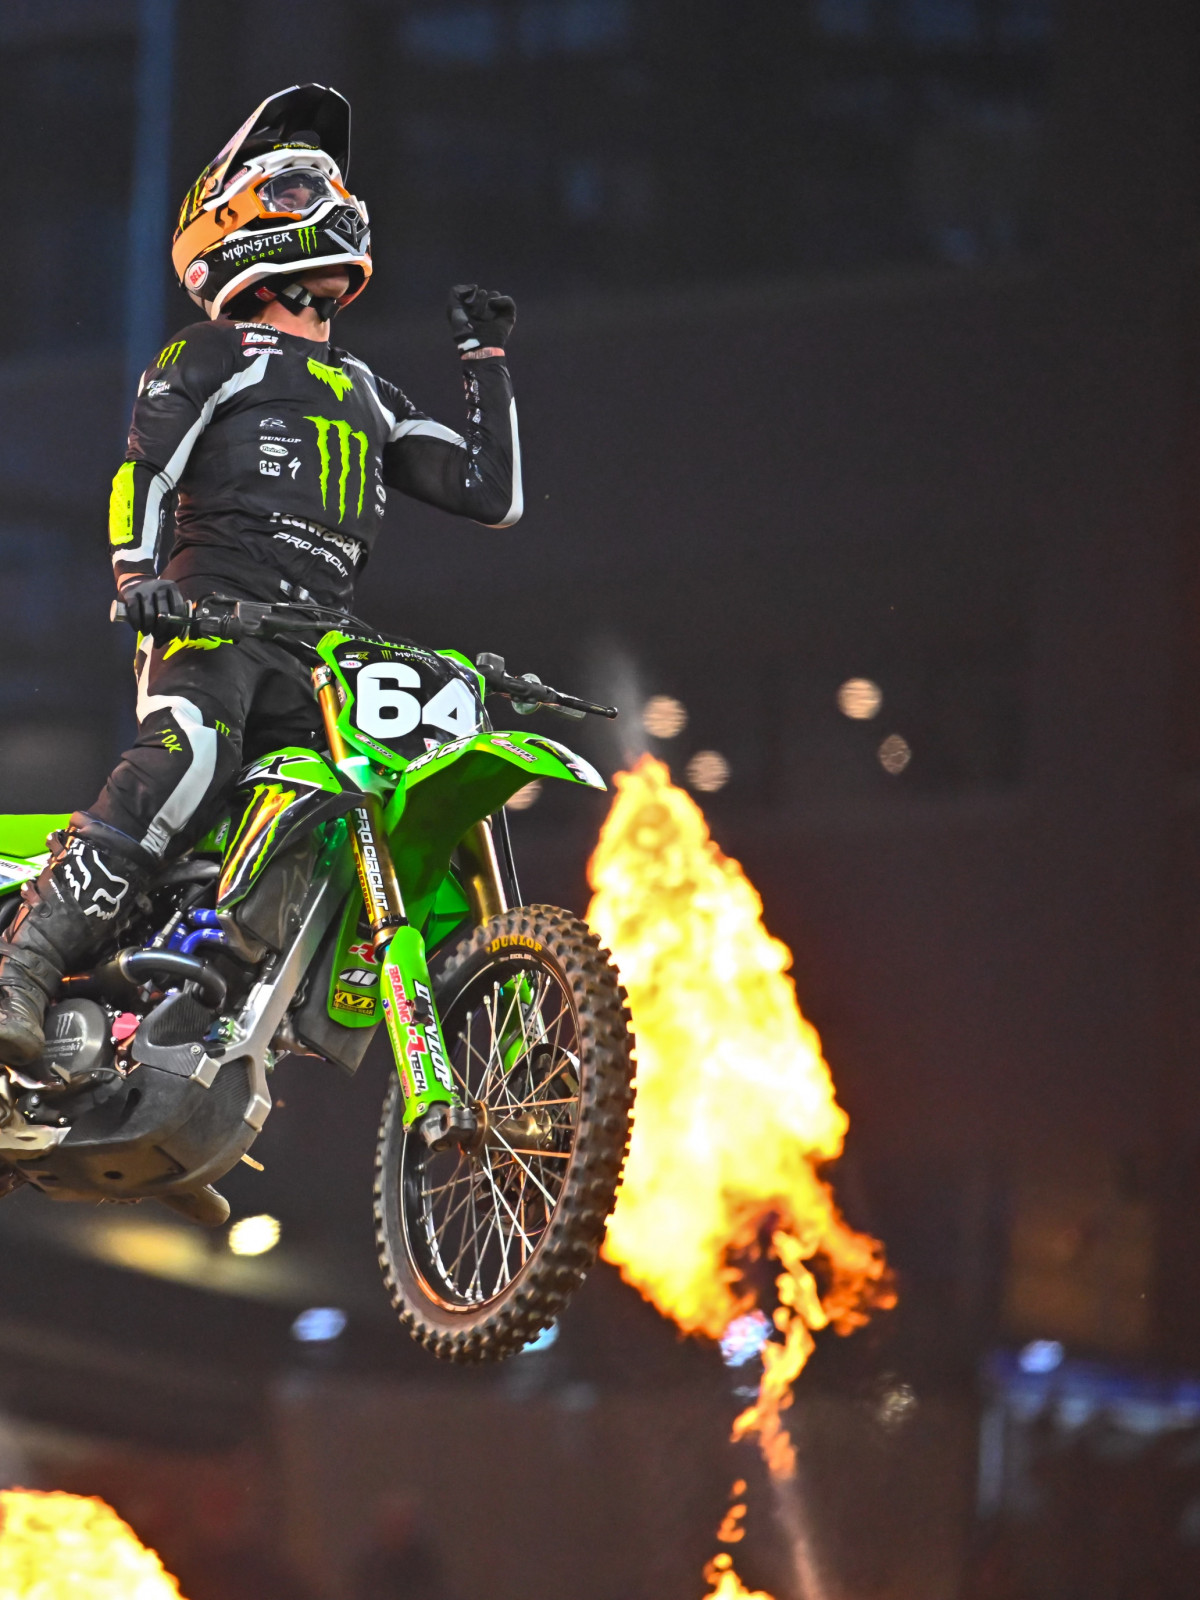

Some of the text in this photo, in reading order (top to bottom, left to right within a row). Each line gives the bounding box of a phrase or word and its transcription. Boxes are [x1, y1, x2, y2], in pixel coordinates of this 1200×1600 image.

[222, 231, 293, 261] MONSTER
[234, 247, 284, 267] ENERGY
[189, 266, 206, 286] BELL
[259, 435, 302, 444] DUNLOP
[260, 462, 280, 473] PPG
[273, 531, 313, 551] PRO
[356, 662, 478, 739] 64
[355, 807, 374, 843] PRO
[363, 845, 389, 911] CIRCUIT
[490, 934, 543, 953] DUNLOP
[388, 964, 412, 1025] BRAKING
[413, 979, 452, 1092] DNLOP
